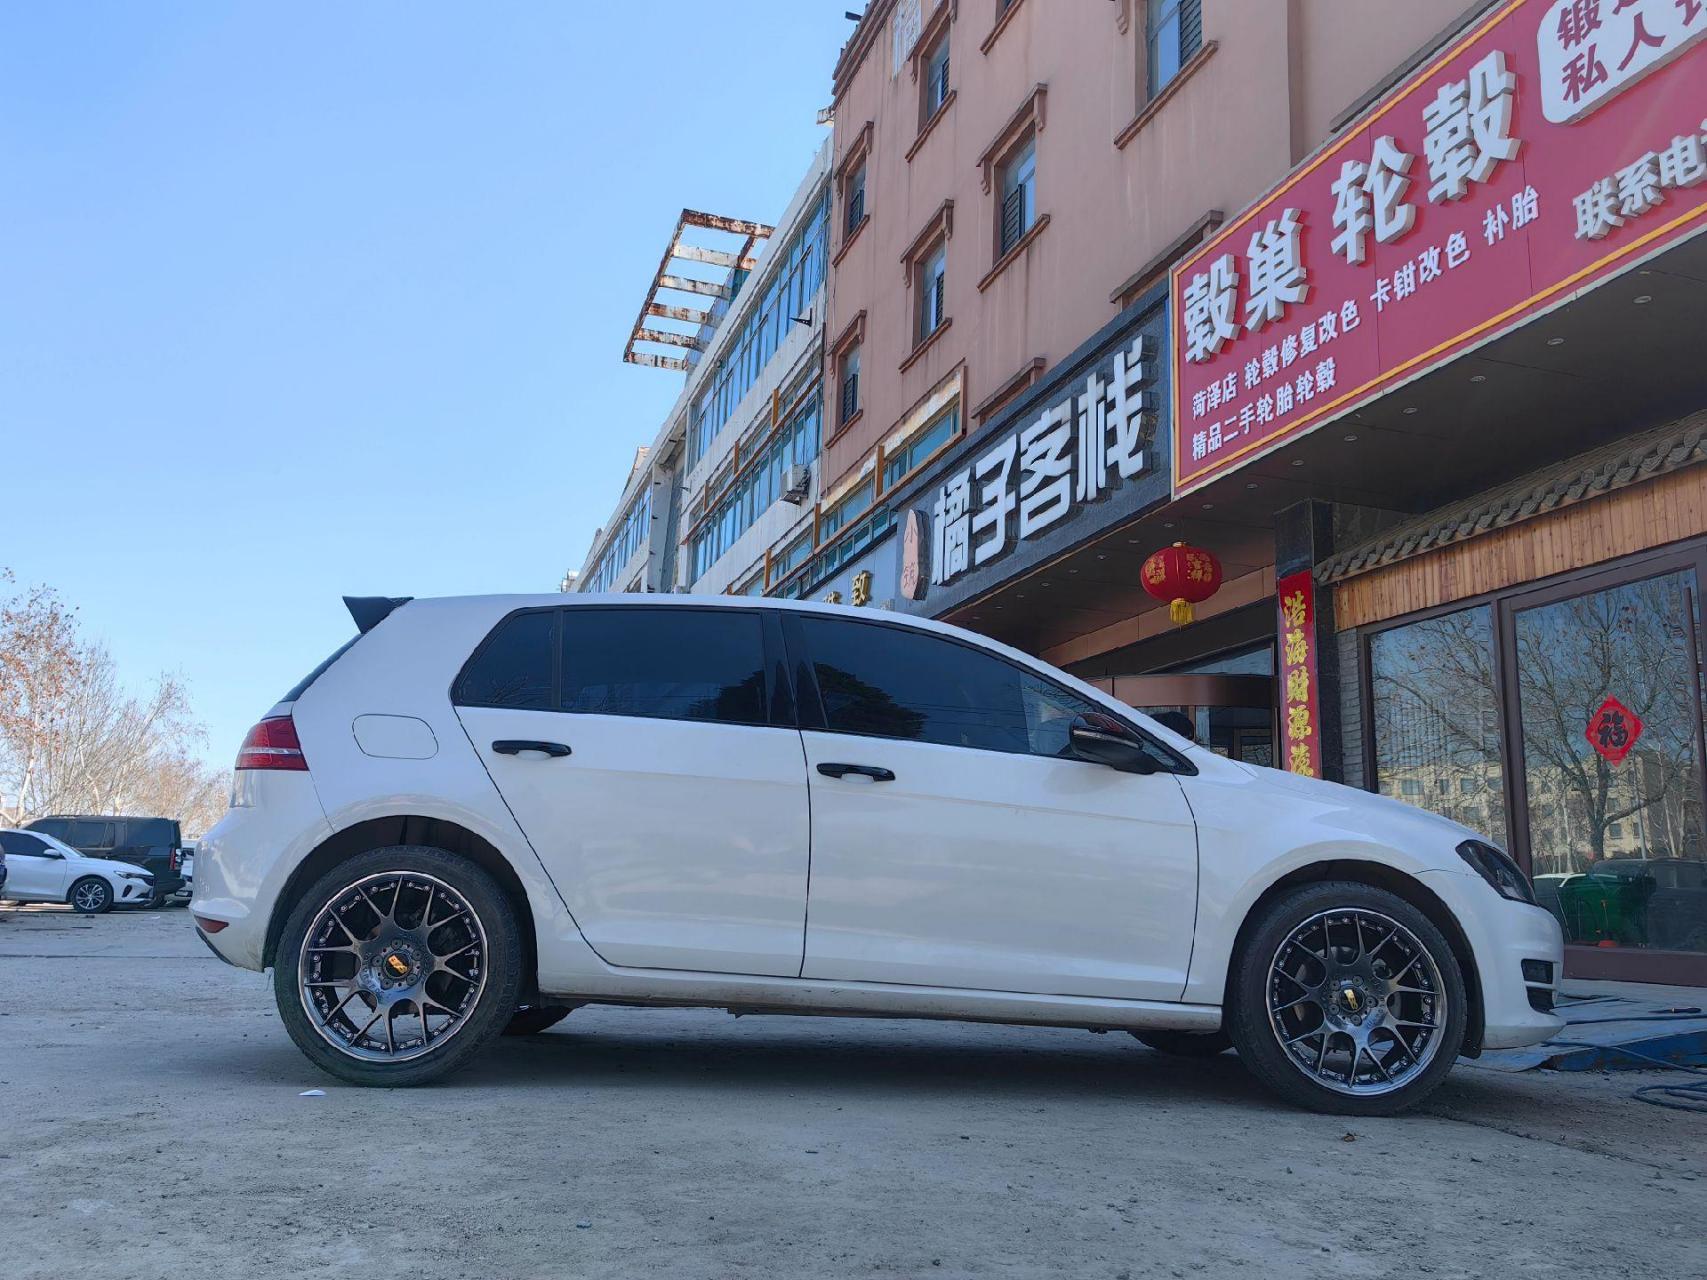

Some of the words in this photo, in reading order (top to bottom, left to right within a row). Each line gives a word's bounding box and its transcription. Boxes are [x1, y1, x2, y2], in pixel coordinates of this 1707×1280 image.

[1331, 50, 1521, 266] 轮毂
[1572, 118, 1707, 240] 联系电
[1192, 371, 1238, 420] 菏泽店
[1244, 299, 1361, 390] 轮毂修复改色
[1369, 230, 1471, 312] 卡钳改色
[1482, 185, 1540, 246] 补胎
[931, 334, 1144, 587] 橘子客栈
[1192, 356, 1337, 461] 精品二手轮胎轮毂
[1597, 710, 1629, 748] 福
